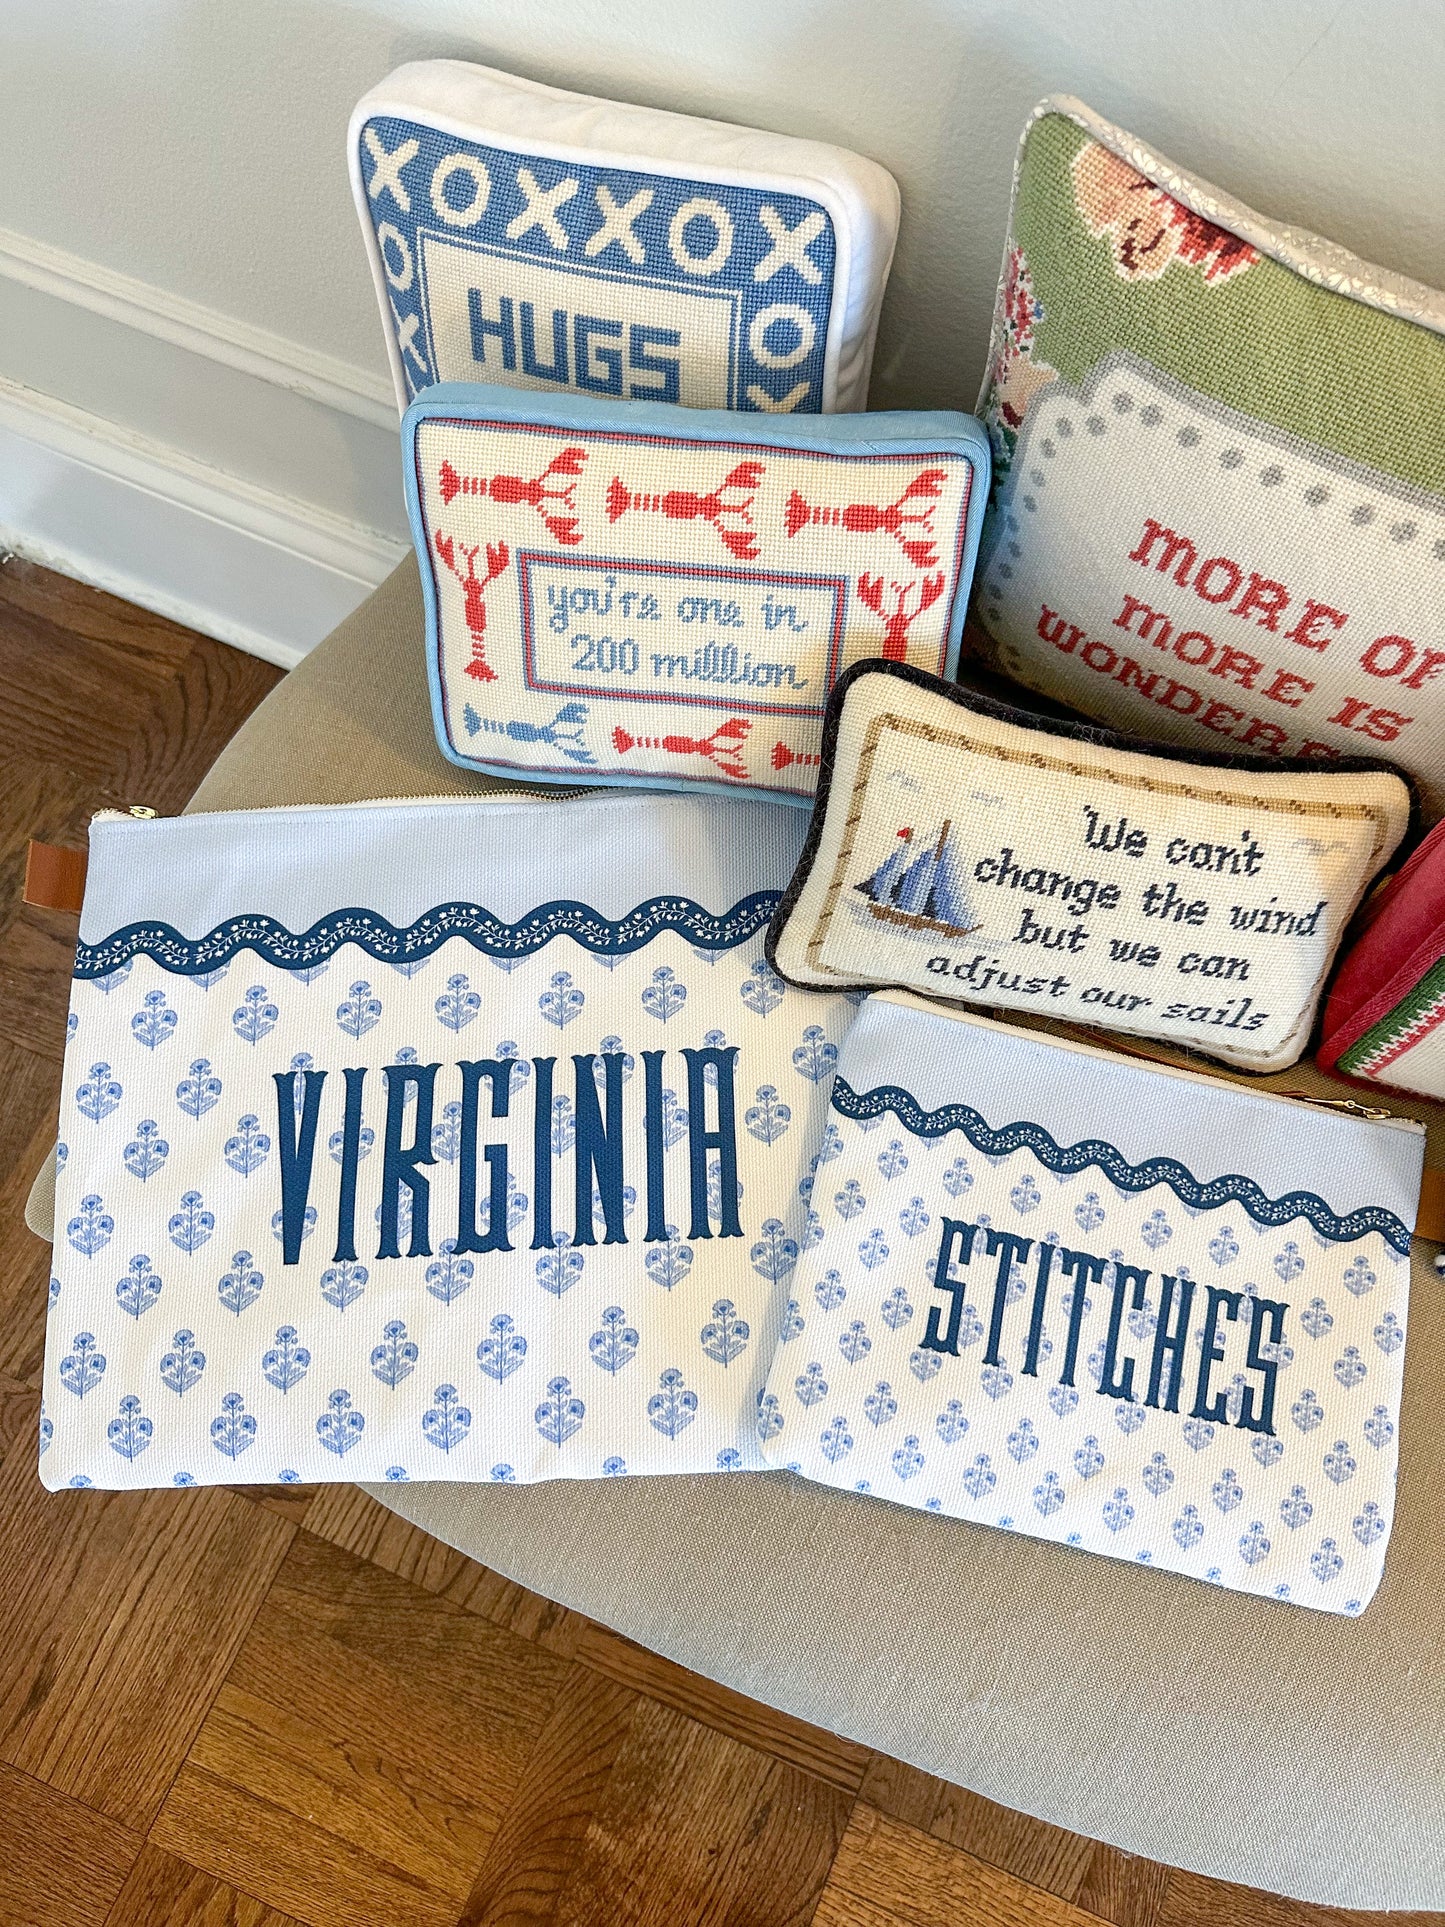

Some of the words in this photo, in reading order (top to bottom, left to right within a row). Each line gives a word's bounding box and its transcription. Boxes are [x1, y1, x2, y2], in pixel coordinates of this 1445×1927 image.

[467, 287, 681, 401] HUGS
[548, 576, 662, 633] you're
[677, 596, 745, 627] one
[761, 594, 809, 632] in
[1128, 518, 1349, 652] MORE
[570, 634, 640, 675] 200
[650, 640, 809, 690] million
[1112, 594, 1317, 708] MORE
[1326, 696, 1415, 742] IS
[1083, 805, 1148, 858] We
[1166, 830, 1266, 878] can't
[973, 848, 1121, 916] change
[1142, 881, 1210, 925] the
[1230, 897, 1328, 938] wind
[1012, 908, 1090, 953] but
[1109, 937, 1161, 970] we
[1176, 951, 1250, 981] can
[926, 953, 1071, 991] adjust
[1079, 984, 1152, 1011] our
[1161, 997, 1271, 1032] sails
[271, 1046, 745, 1266] VIRGINIA
[918, 1216, 1291, 1436] STITCHES
